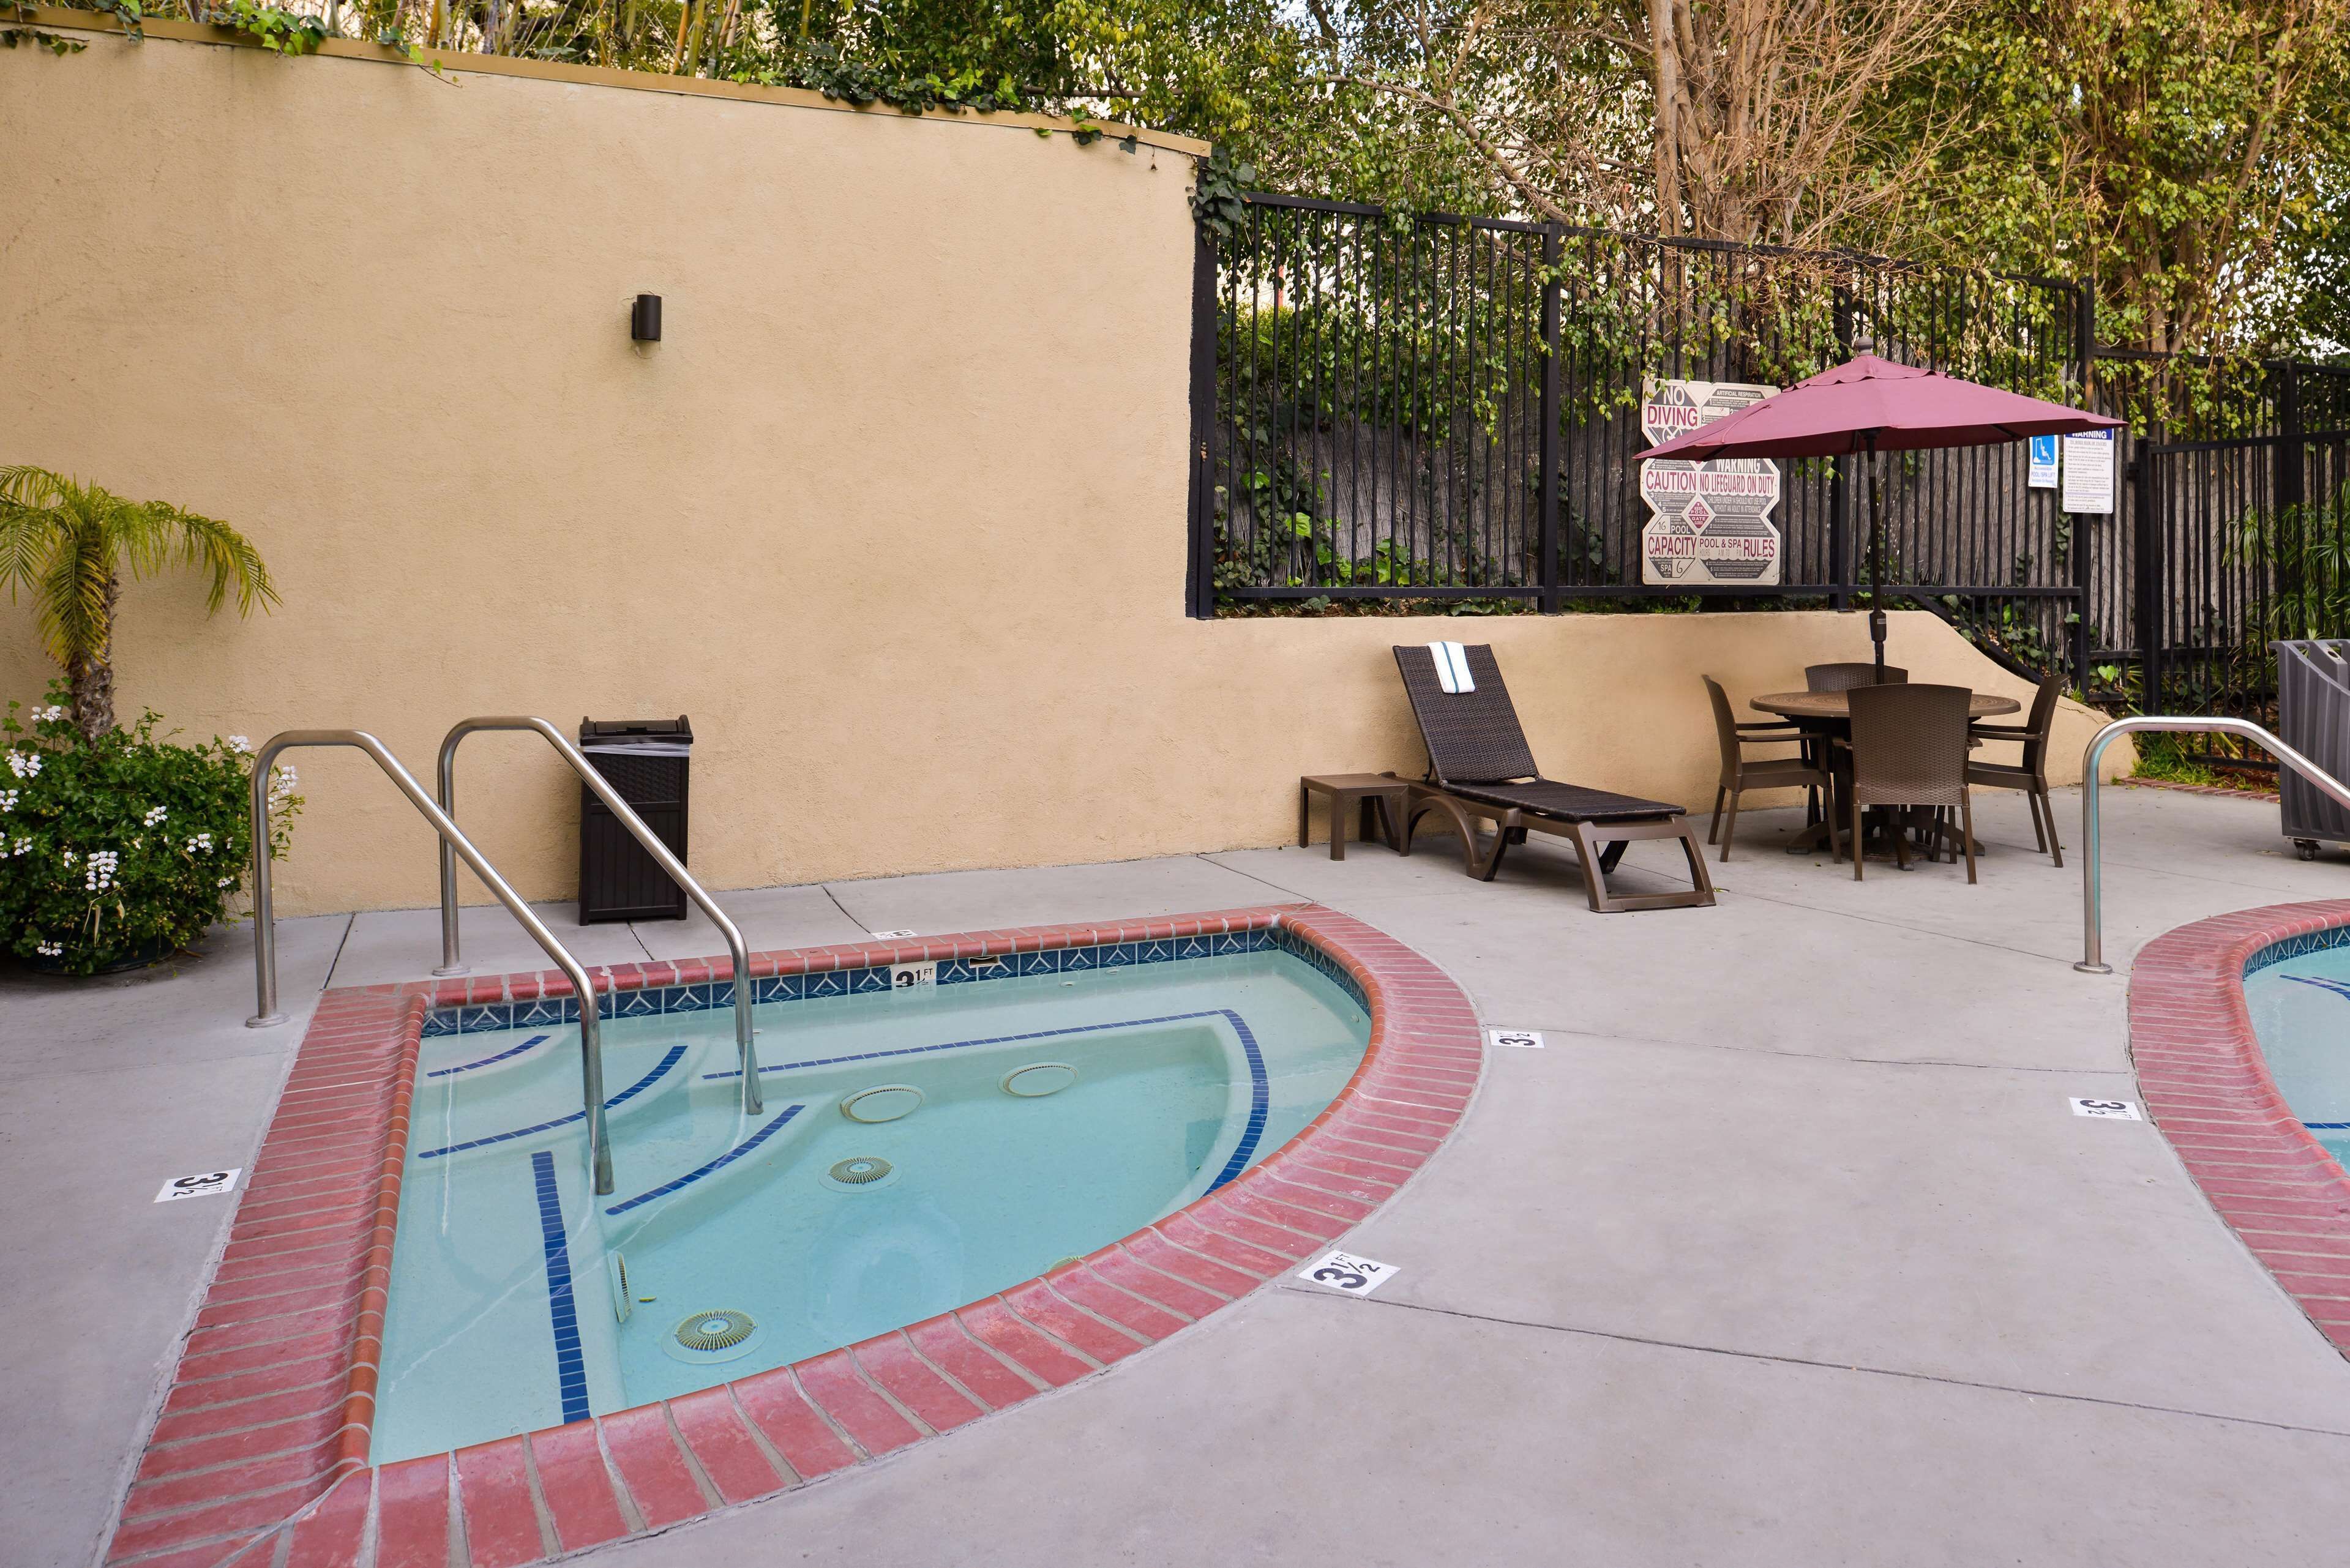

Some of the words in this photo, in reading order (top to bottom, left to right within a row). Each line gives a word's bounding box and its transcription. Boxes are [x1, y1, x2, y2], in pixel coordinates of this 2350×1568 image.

[1663, 386, 1685, 406] NO
[1648, 406, 1697, 427] DIVING
[1716, 459, 1761, 474] WARNING
[1646, 471, 1696, 490] CAUTION
[1700, 474, 1709, 492] NO
[1712, 474, 1745, 493] LIFEGUARD
[1748, 475, 1756, 493] ON
[1759, 476, 1775, 494] DUTY
[1671, 525, 1691, 534] POOL
[1648, 536, 1697, 556] CAPACITY
[1700, 539, 1719, 548] POOL
[1721, 539, 1726, 548] &
[1728, 539, 1742, 548] SPA
[1743, 539, 1775, 558] RULES
[1677, 560, 1683, 573] 6
